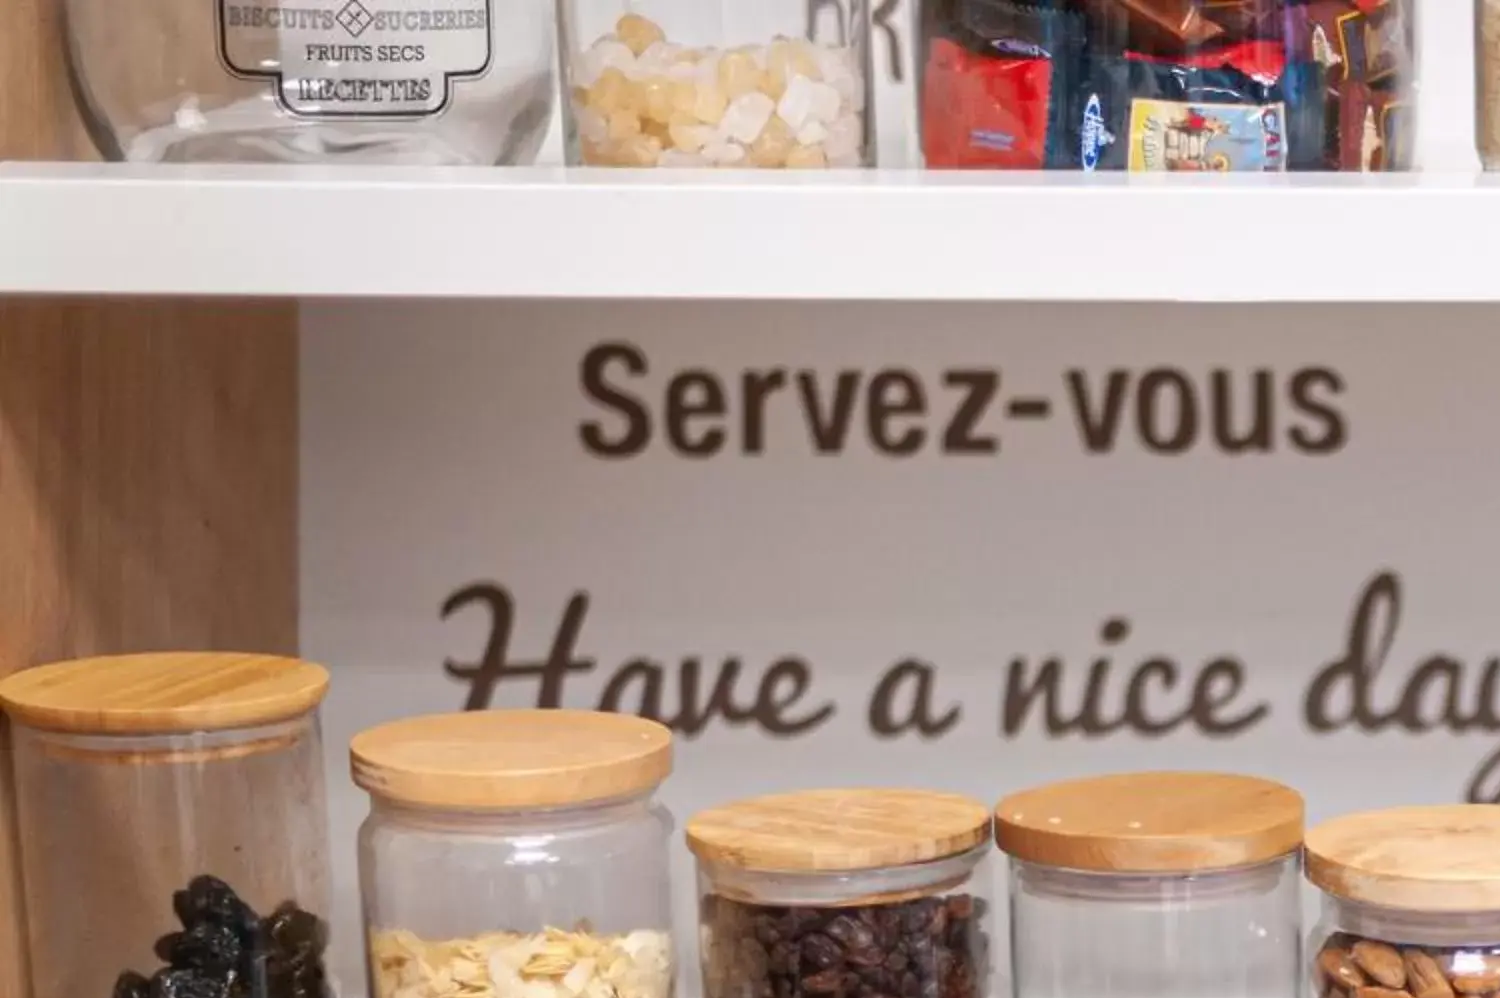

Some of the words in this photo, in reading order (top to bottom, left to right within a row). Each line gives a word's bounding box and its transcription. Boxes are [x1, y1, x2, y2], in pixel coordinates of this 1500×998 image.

[228, 6, 335, 28] BISCUITS
[373, 8, 486, 32] SUCRERIES
[305, 44, 373, 62] FRUITS
[377, 45, 425, 62] SECS
[299, 79, 431, 102] RECETTES
[577, 341, 1347, 459] Servez-vous
[439, 580, 835, 739] Have
[867, 657, 961, 739] a
[1001, 617, 1268, 738] nice
